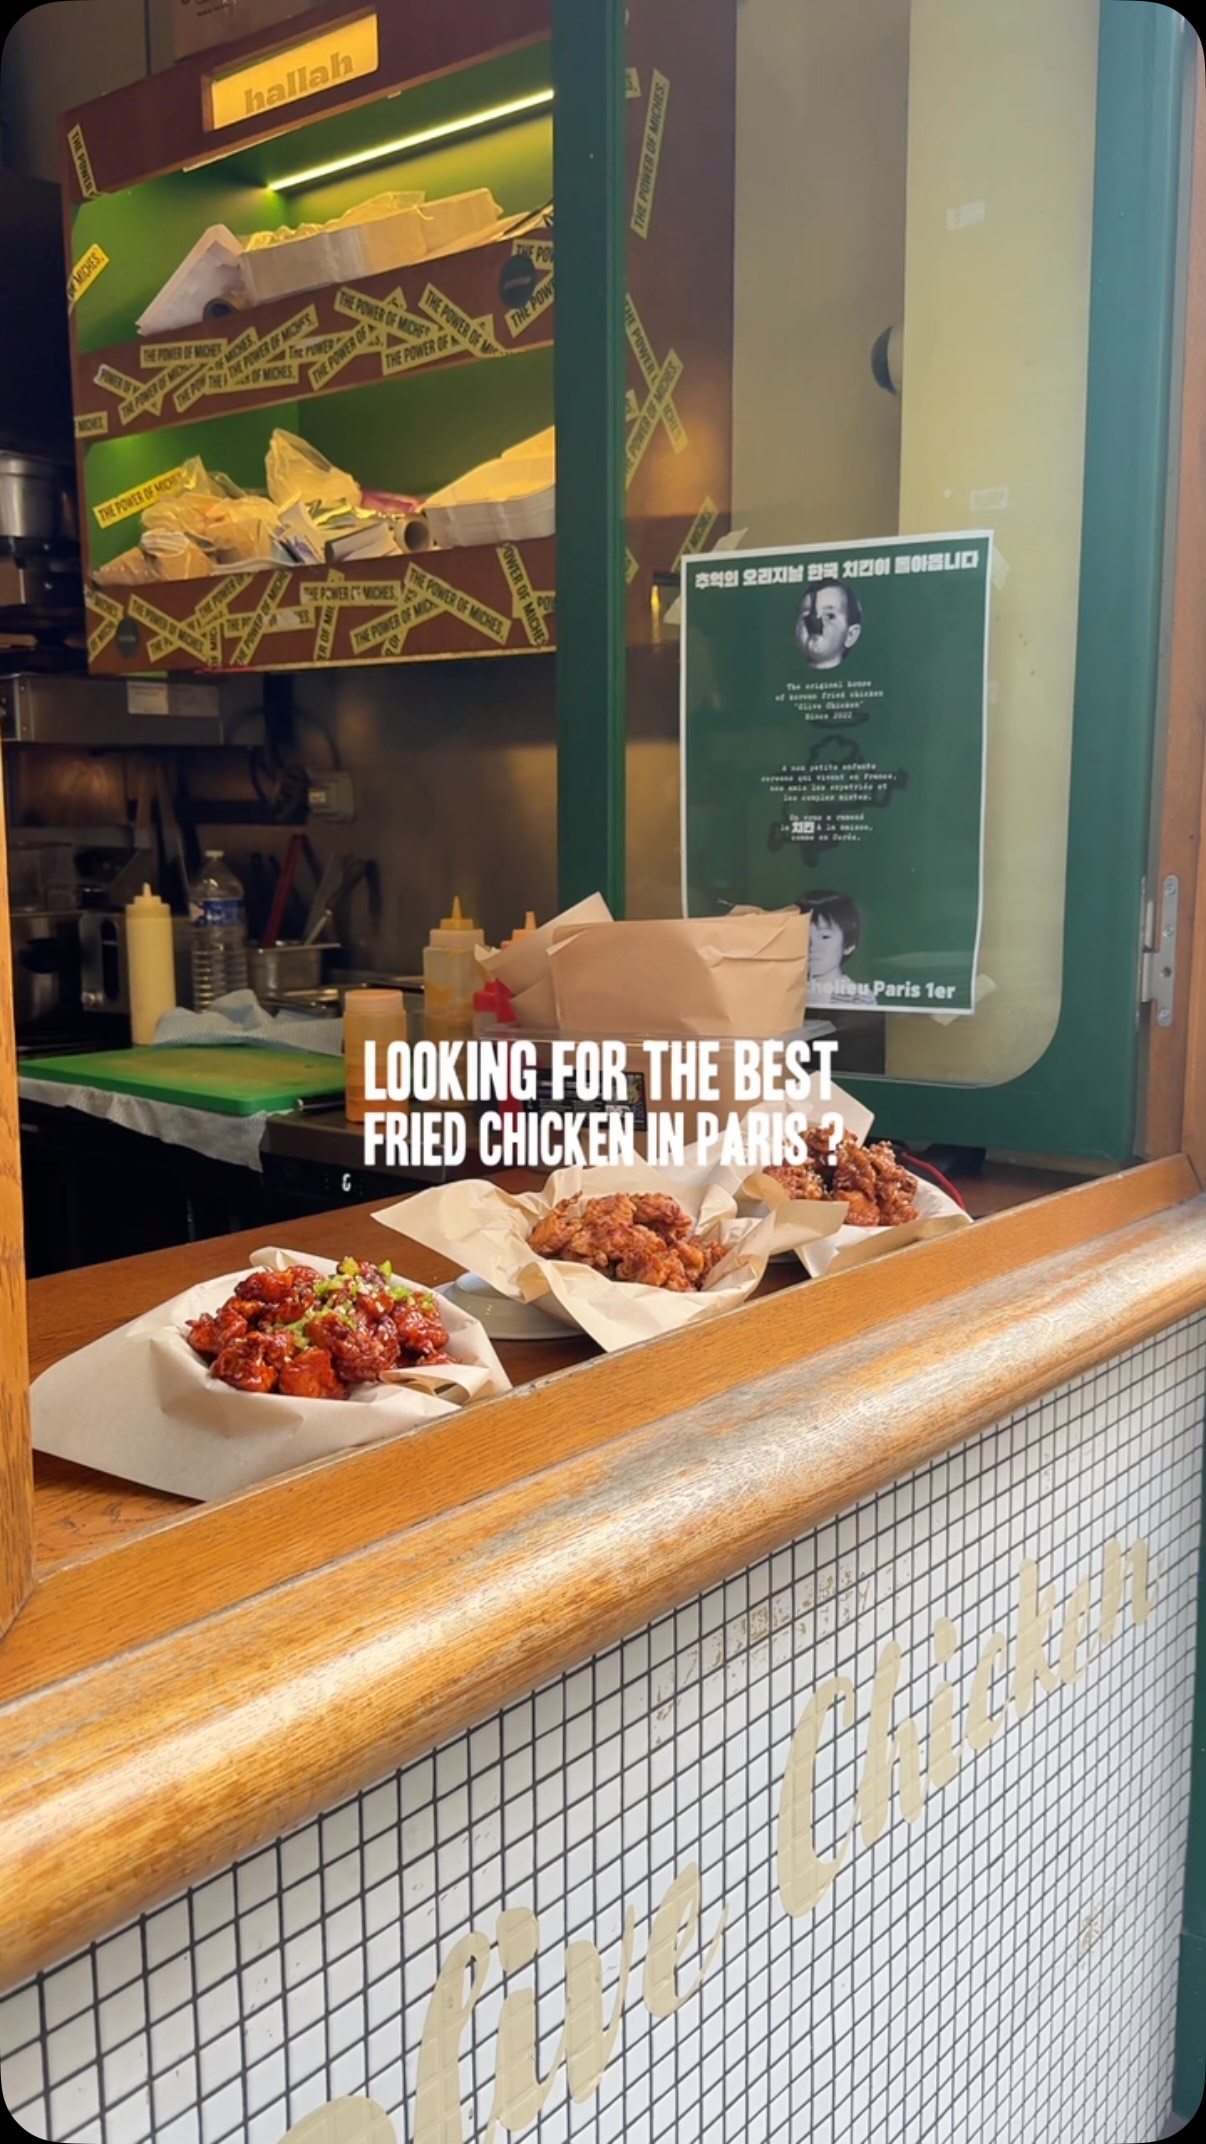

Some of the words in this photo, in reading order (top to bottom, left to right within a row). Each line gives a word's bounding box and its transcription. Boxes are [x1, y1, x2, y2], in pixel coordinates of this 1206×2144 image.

[244, 52, 354, 114] hallah
[340, 291, 356, 311] THE
[355, 298, 385, 323] POWER
[425, 289, 443, 314] THE
[440, 304, 471, 339] POWER
[403, 340, 436, 363] POWER
[695, 570, 739, 589] 추억의
[807, 562, 839, 581] 한국
[842, 557, 891, 578] 치킨이
[409, 567, 426, 590] THE
[425, 579, 458, 607] POWER
[787, 683, 801, 691] The
[805, 681, 843, 690] original
[775, 693, 786, 701] of
[822, 691, 845, 699] fried
[849, 690, 884, 698] chicken
[805, 712, 829, 720] Since
[832, 711, 853, 719] 2022
[809, 764, 838, 772] petits
[797, 775, 812, 783] qui
[811, 783, 826, 791] les
[783, 794, 798, 802] les
[801, 794, 835, 802] couples
[789, 813, 799, 821] On
[826, 823, 836, 831] la
[874, 980, 920, 997] Paris
[925, 982, 956, 998] 1er
[777, 1538, 1165, 1918] Chicken
